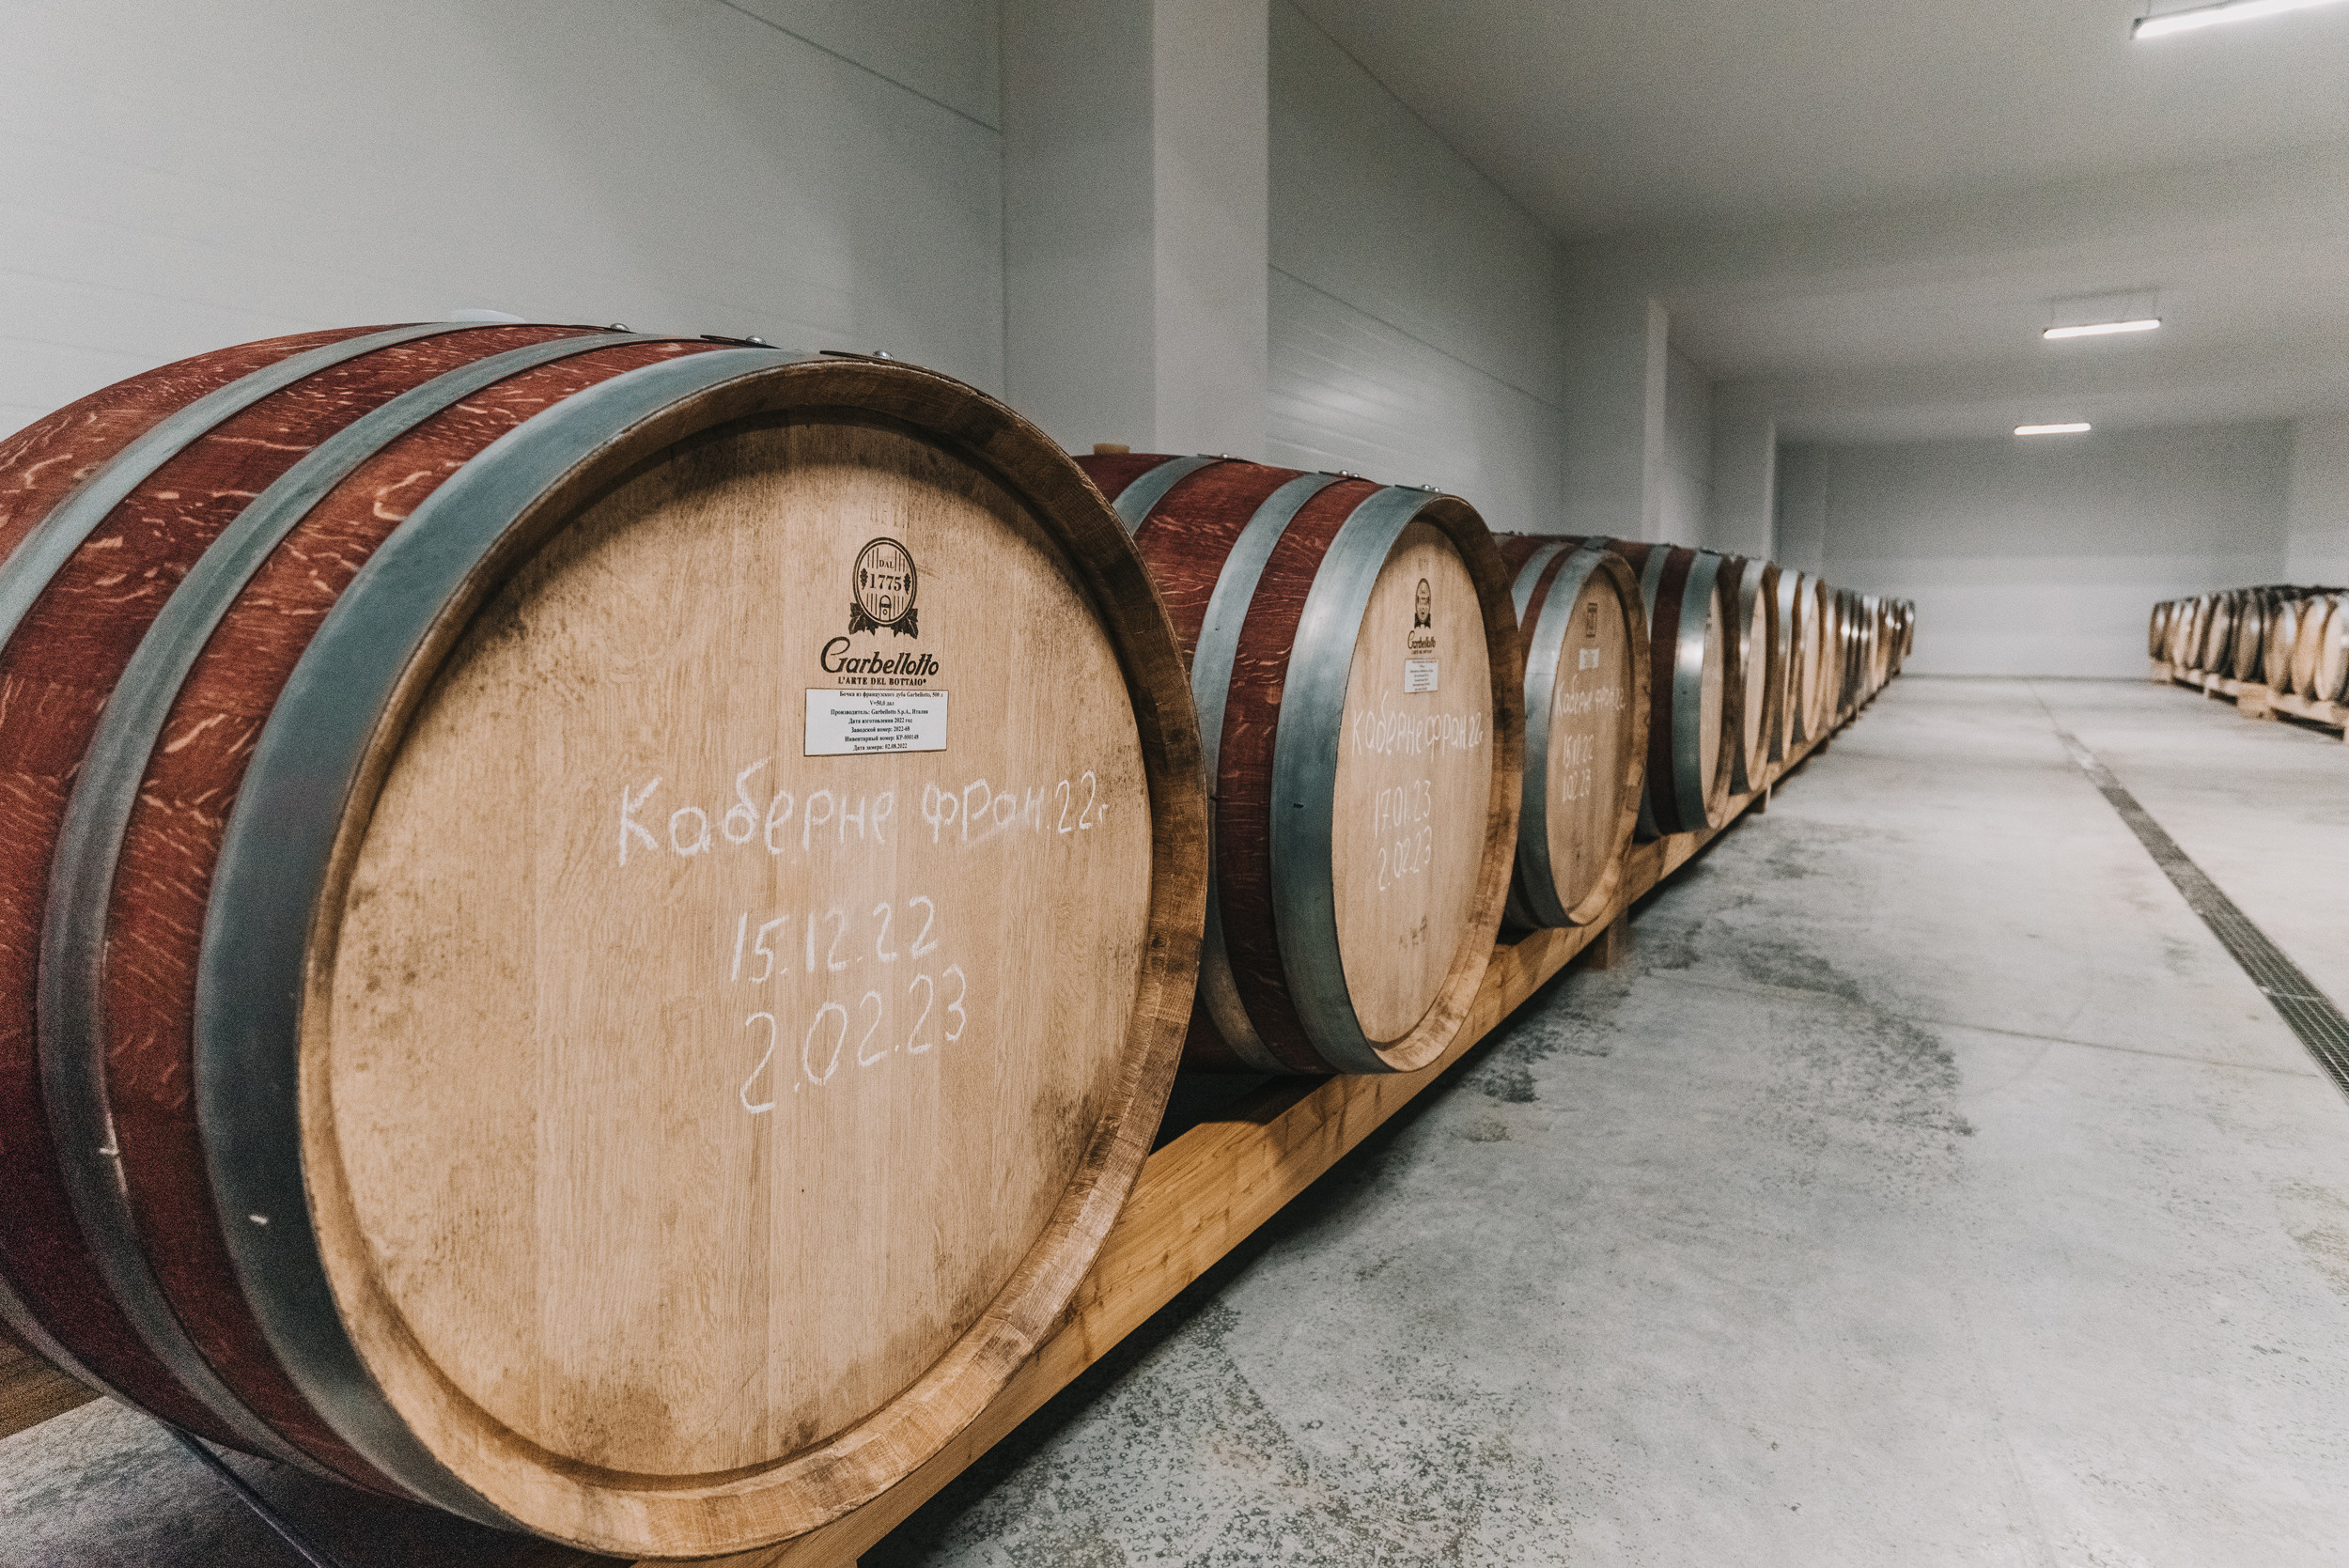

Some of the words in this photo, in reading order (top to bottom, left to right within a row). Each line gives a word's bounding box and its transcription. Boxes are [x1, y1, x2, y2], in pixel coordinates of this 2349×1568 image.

[869, 573, 902, 592] 1775
[879, 559, 894, 569] DAL
[820, 636, 940, 676] Garbellotto
[870, 677, 887, 686] DEL
[618, 756, 894, 867] Каберне
[731, 895, 938, 983] 15.12.22
[740, 964, 968, 1113] 2.02.23
